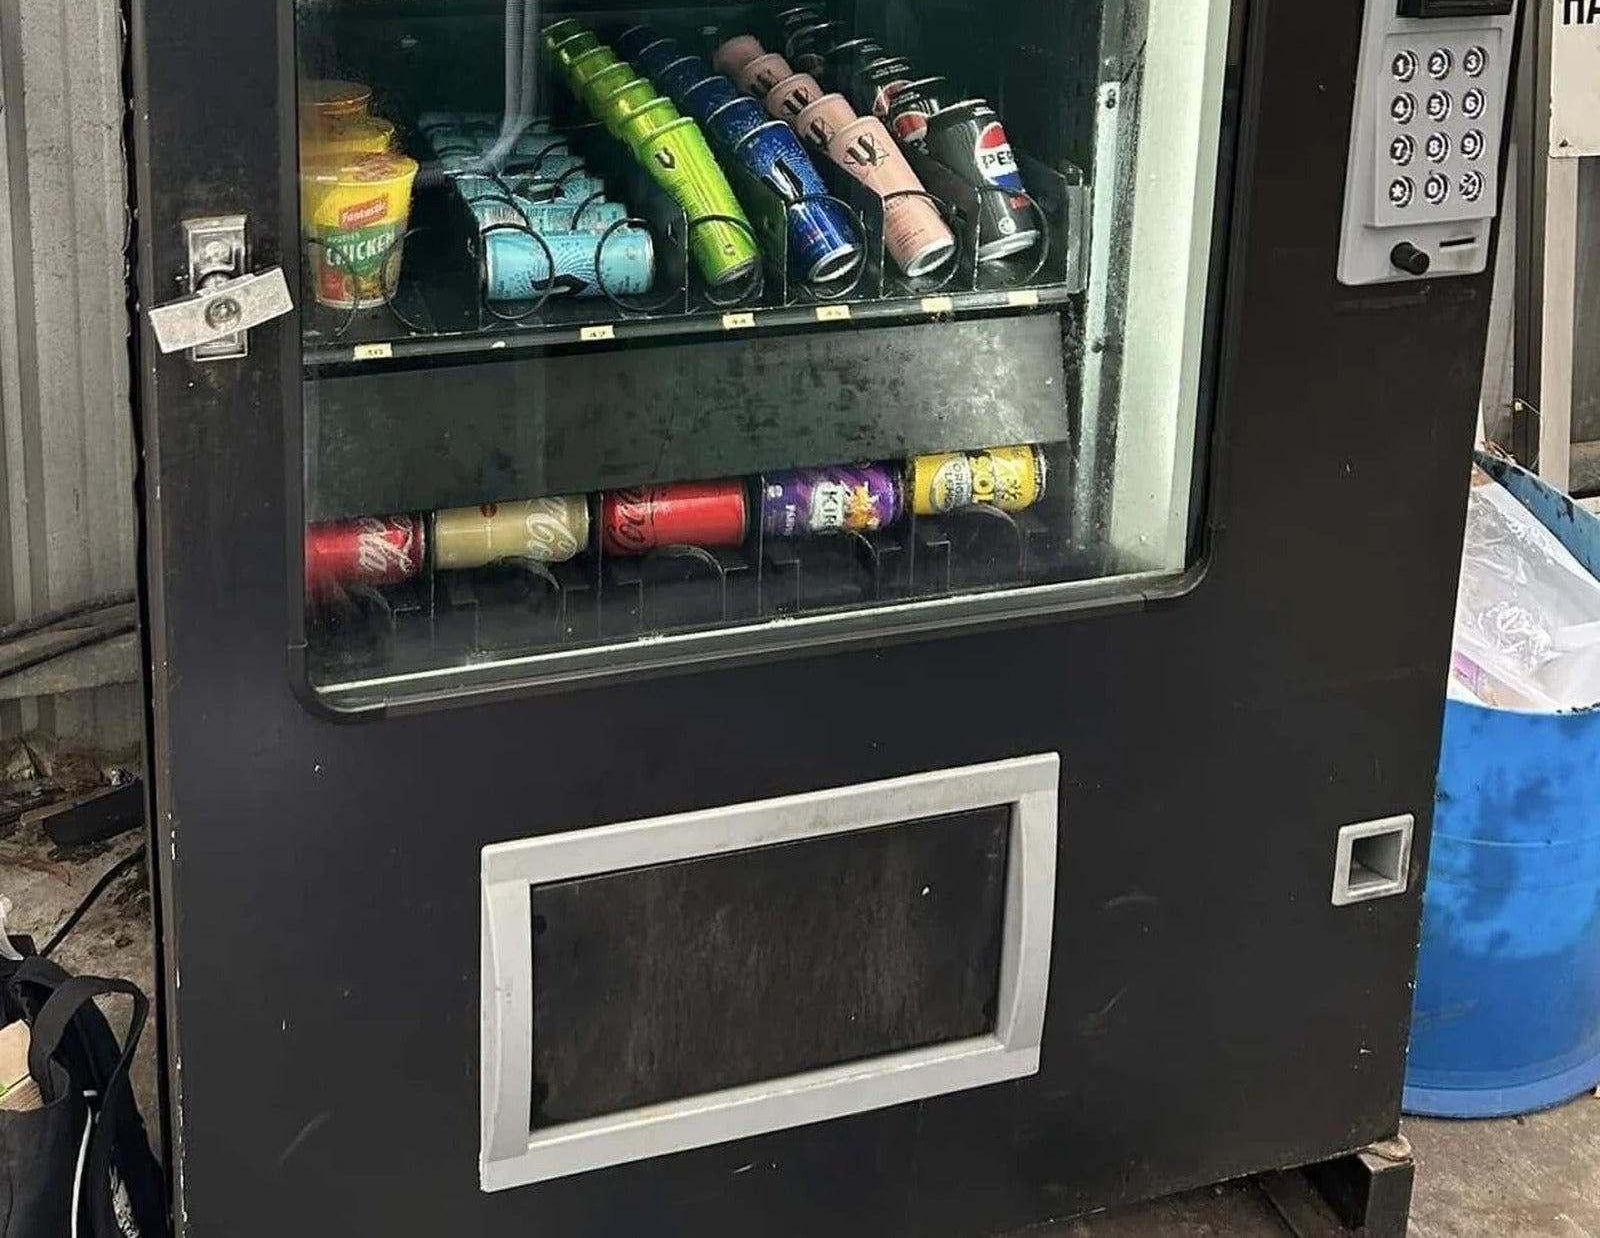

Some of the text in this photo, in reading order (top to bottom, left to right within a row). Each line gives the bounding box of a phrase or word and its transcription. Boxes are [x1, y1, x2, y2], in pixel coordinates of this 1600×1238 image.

[1396, 54, 1477, 74] 1 2 3
[1395, 95, 1476, 115] 4 5 6
[1393, 137, 1475, 157] 7 8 9
[1427, 181, 1439, 197] 0
[970, 455, 996, 504] SOL
[821, 489, 839, 526] KIR
